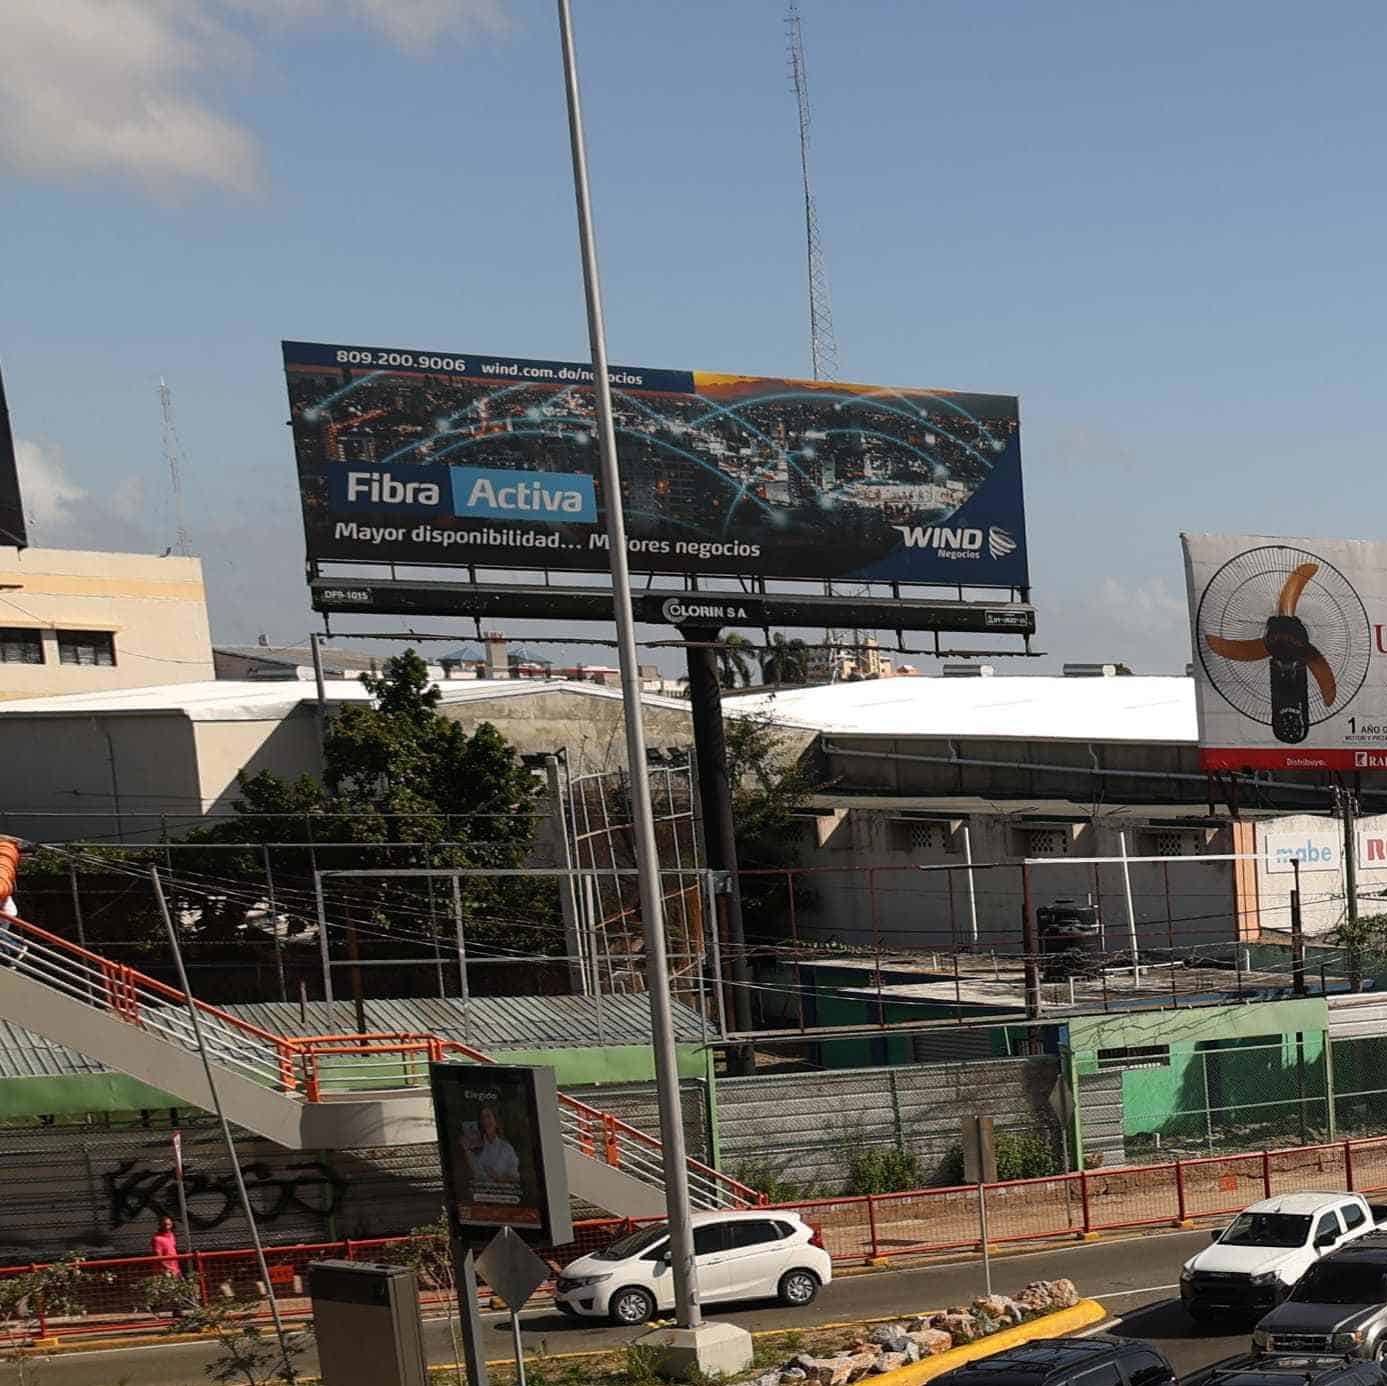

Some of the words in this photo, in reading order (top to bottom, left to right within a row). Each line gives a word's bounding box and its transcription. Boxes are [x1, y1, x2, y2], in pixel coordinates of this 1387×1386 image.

[336, 349, 466, 373] 809.200.9006
[481, 361, 643, 386] wind.com.do/nocios
[347, 471, 440, 506] Fibra
[467, 478, 583, 513] Activa
[334, 522, 407, 545] Mayor
[411, 525, 582, 550] disponibilidad...
[676, 539, 761, 559] negocios
[896, 525, 984, 550] WIND
[937, 549, 981, 560] Negocios
[1347, 716, 1356, 734] 1
